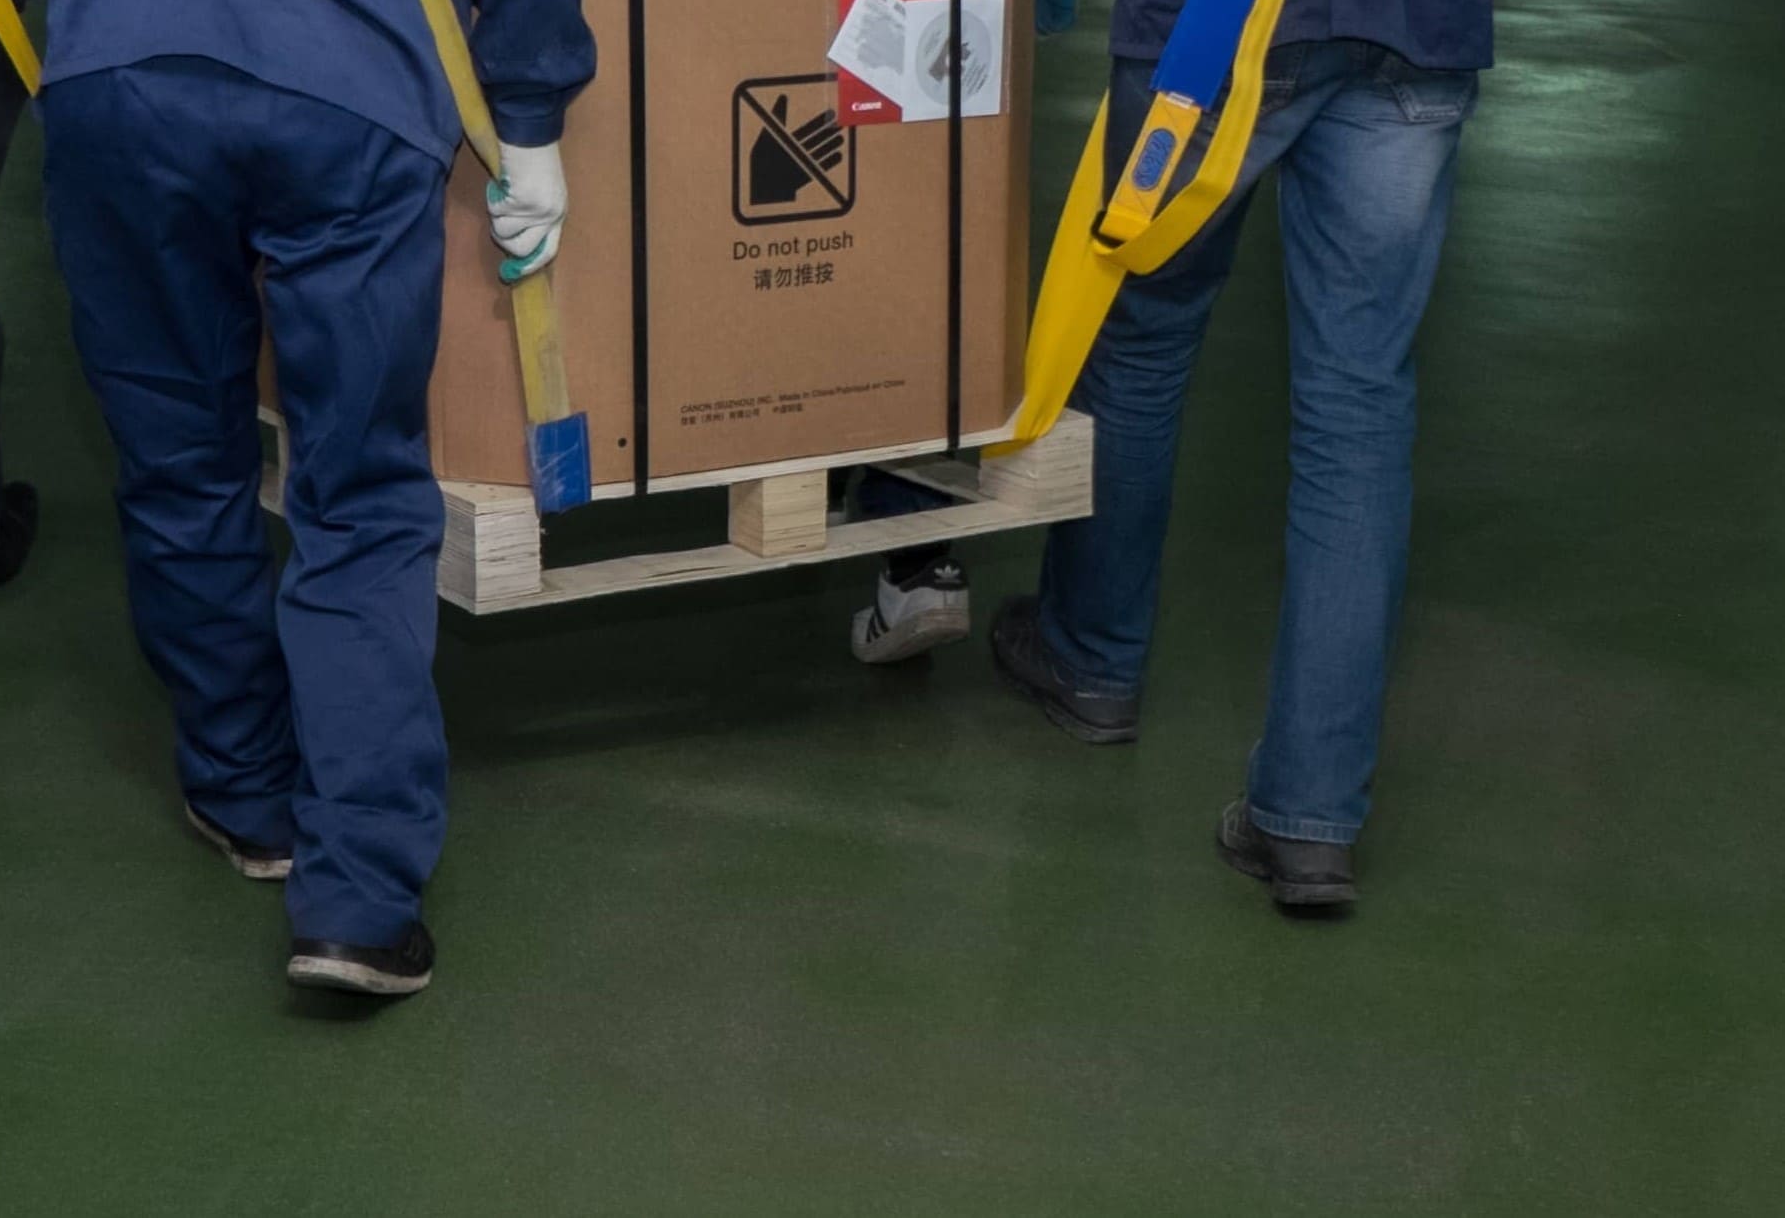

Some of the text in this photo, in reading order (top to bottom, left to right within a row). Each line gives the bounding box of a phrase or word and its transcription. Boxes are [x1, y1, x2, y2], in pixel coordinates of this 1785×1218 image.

[851, 101, 882, 112] Canon
[733, 231, 854, 261] Do not push
[753, 262, 835, 292] 请勿推按
